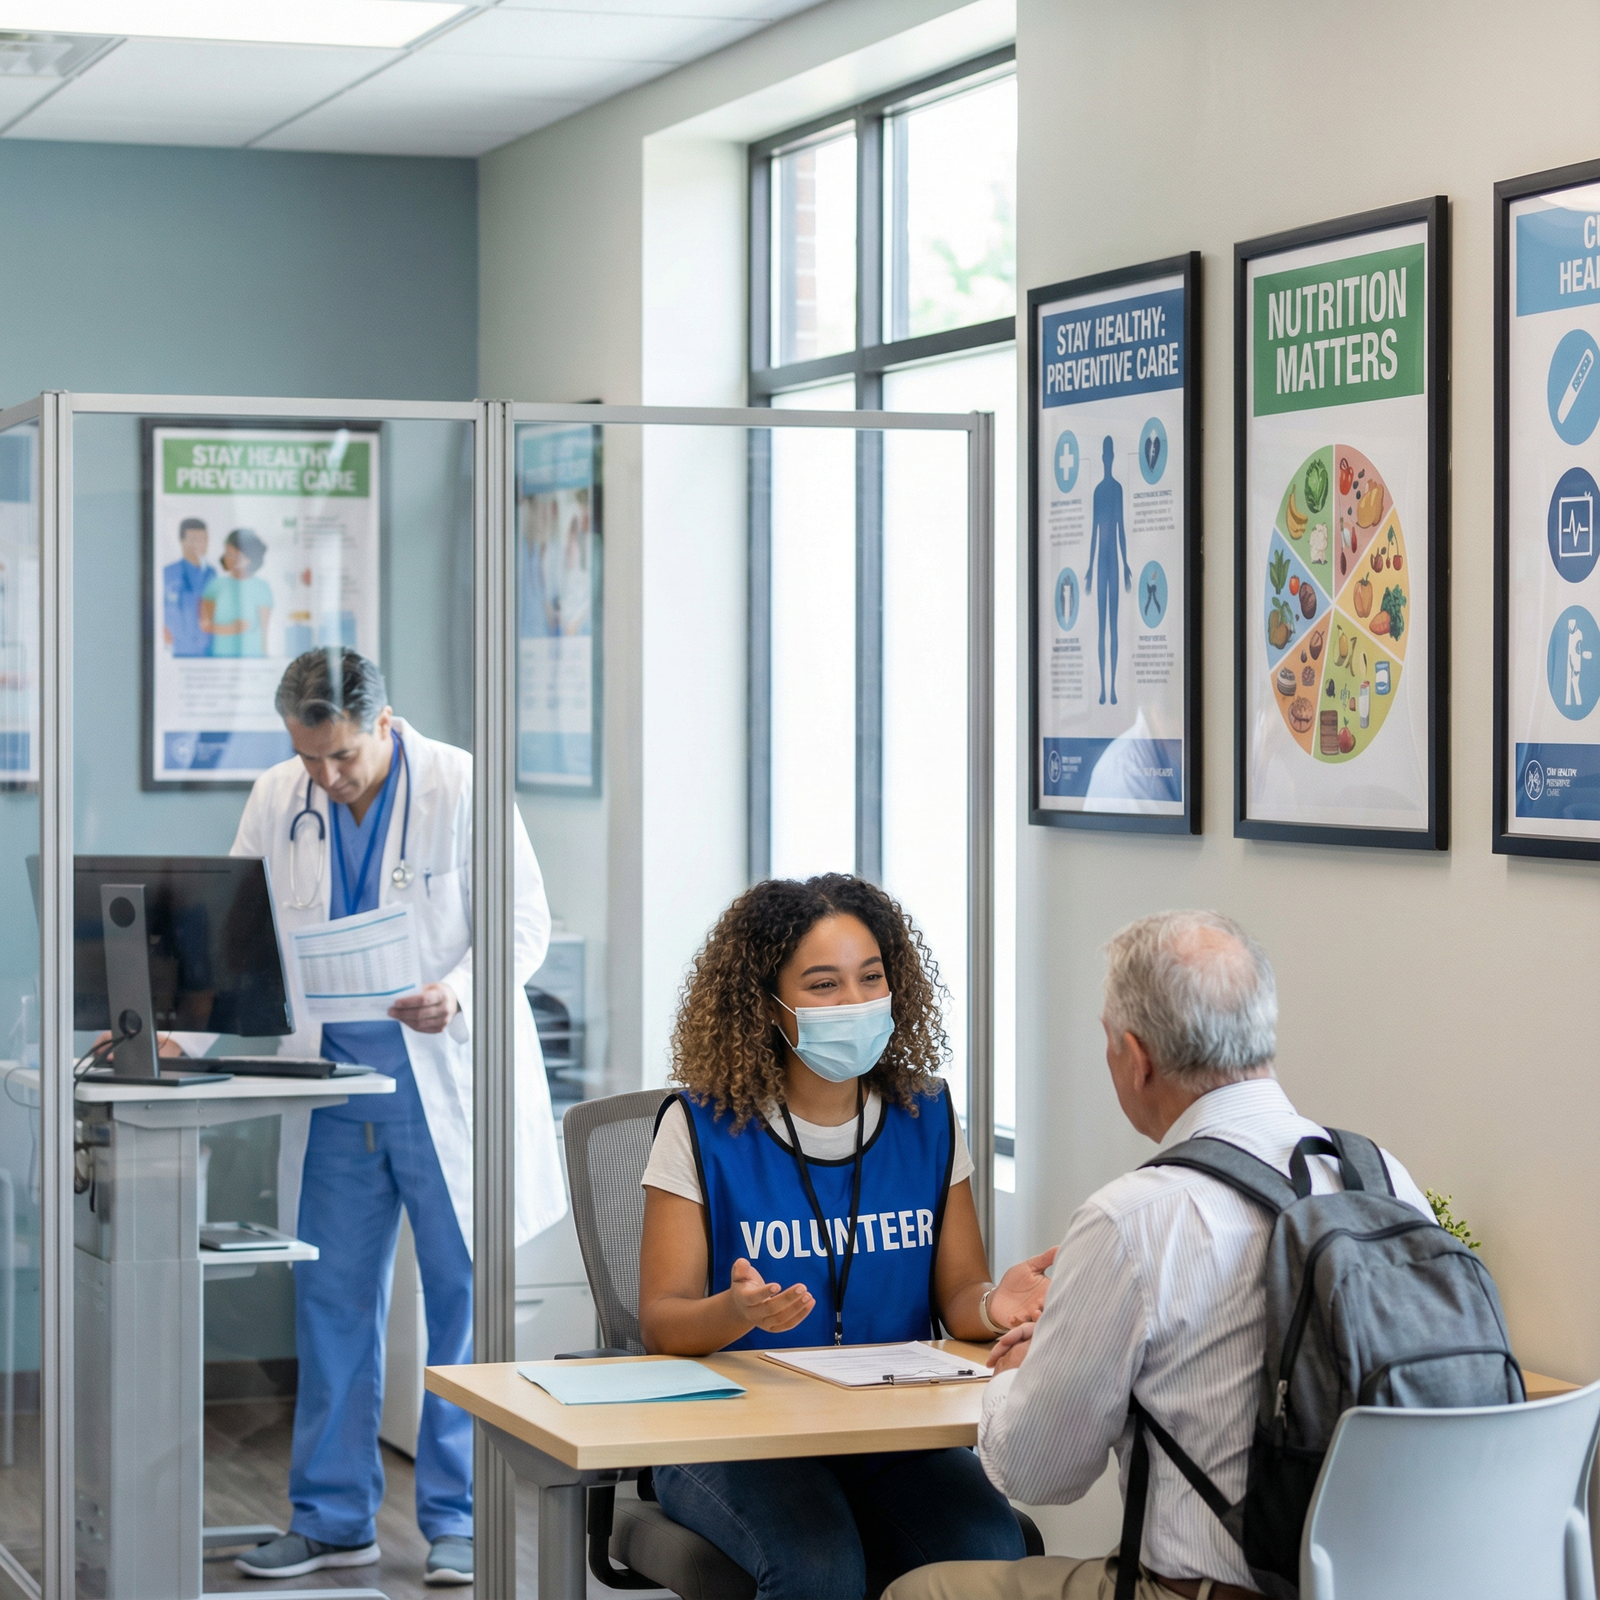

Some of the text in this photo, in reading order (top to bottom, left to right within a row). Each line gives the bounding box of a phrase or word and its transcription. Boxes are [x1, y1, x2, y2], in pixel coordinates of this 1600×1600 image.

[1268, 267, 1406, 340] NUTRITION
[1057, 306, 1166, 356] STAY HEALTHY:
[1047, 342, 1179, 395] PREVENTIVE CARE
[1276, 328, 1398, 394] MATTERS
[176, 467, 357, 492] PREVENTIVE CARE
[192, 444, 243, 466] STAY
[740, 1208, 934, 1260] VOLUNTEER
